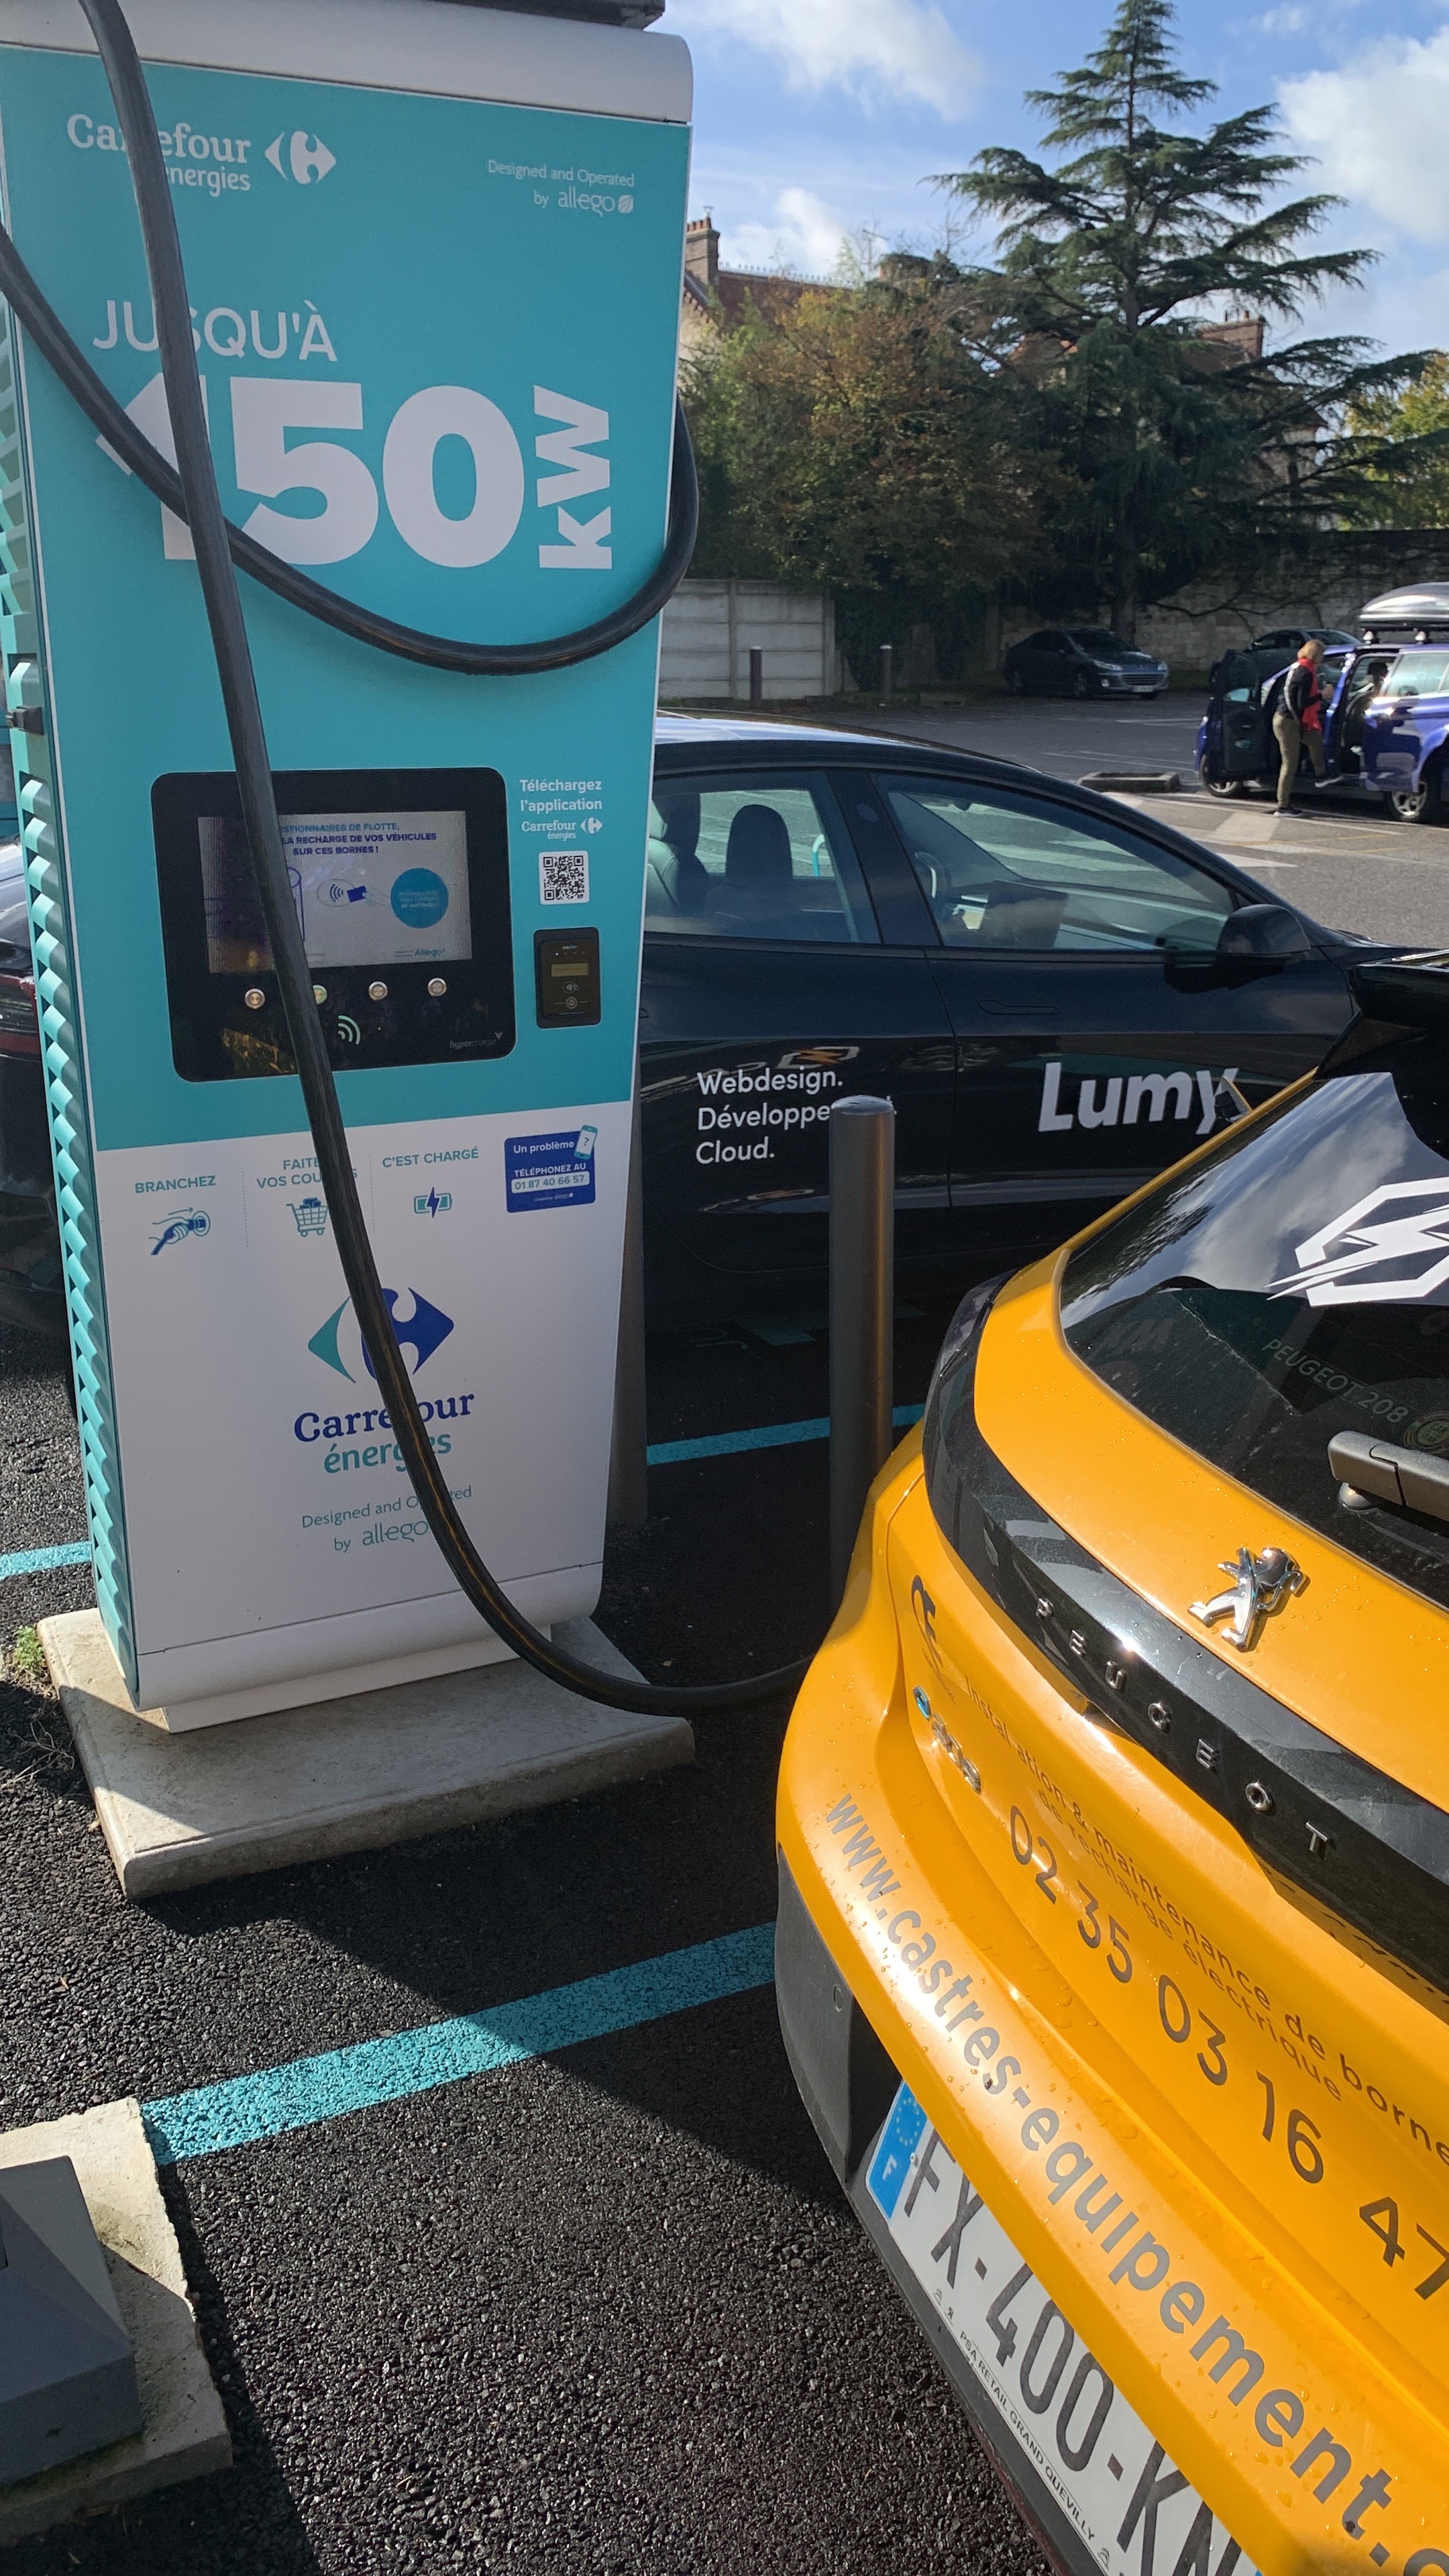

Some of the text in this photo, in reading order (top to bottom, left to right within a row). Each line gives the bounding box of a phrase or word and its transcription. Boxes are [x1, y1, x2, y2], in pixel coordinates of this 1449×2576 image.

[68, 113, 251, 164] Caefour
[165, 166, 250, 197] nergies
[488, 159, 634, 187] Designed and Operated
[534, 186, 614, 217] by allego
[534, 384, 612, 570] kW
[519, 778, 602, 794] Téléchargez
[520, 798, 602, 814] l'application
[279, 822, 399, 833] ESTIONNAIRES DE FLOTTE,
[296, 835, 348, 845] RECHARGE
[350, 835, 362, 843] DE
[364, 834, 384, 843] VOS
[521, 820, 576, 832] Carrefour
[547, 831, 576, 841] énergies
[292, 847, 313, 856] SUR
[315, 847, 333, 855] CES
[335, 846, 374, 855] BORNES
[697, 1065, 843, 1095] Webdesign.
[1038, 1061, 1238, 1135] Lumy
[382, 1146, 479, 1168] C'EST CHARGÉ
[513, 1144, 527, 1154] Un
[530, 1141, 575, 1155] problème
[696, 1136, 775, 1165] Cloud.
[283, 1157, 320, 1170] FAITE
[515, 1163, 586, 1177] TÉLÉPHONEZ AU
[135, 1175, 216, 1193] BRANCHEZ
[256, 1168, 358, 1189] VOS COUS
[515, 1175, 585, 1190] 01 87 40 66 57
[1262, 1338, 1409, 1423] PEUGEOT 208
[294, 1393, 474, 1442] Carreour
[324, 1433, 451, 1473] énergs
[302, 1502, 370, 1527] Designed
[375, 1497, 401, 1515] and
[334, 1519, 429, 1552] by allego
[1035, 1597, 1333, 1857] PEUGEOT
[1038, 1788, 1342, 2101] de recharge électrique
[1073, 1801, 1088, 1832] &
[1093, 1826, 1271, 2011] maintenance
[1284, 2013, 1326, 2061] de
[1010, 1805, 1449, 2300] 02 35 03 16 47
[882, 2153, 898, 2181] F
[960, 2330, 1095, 2541] PSA RETAIL GRAND QUEVILLY
